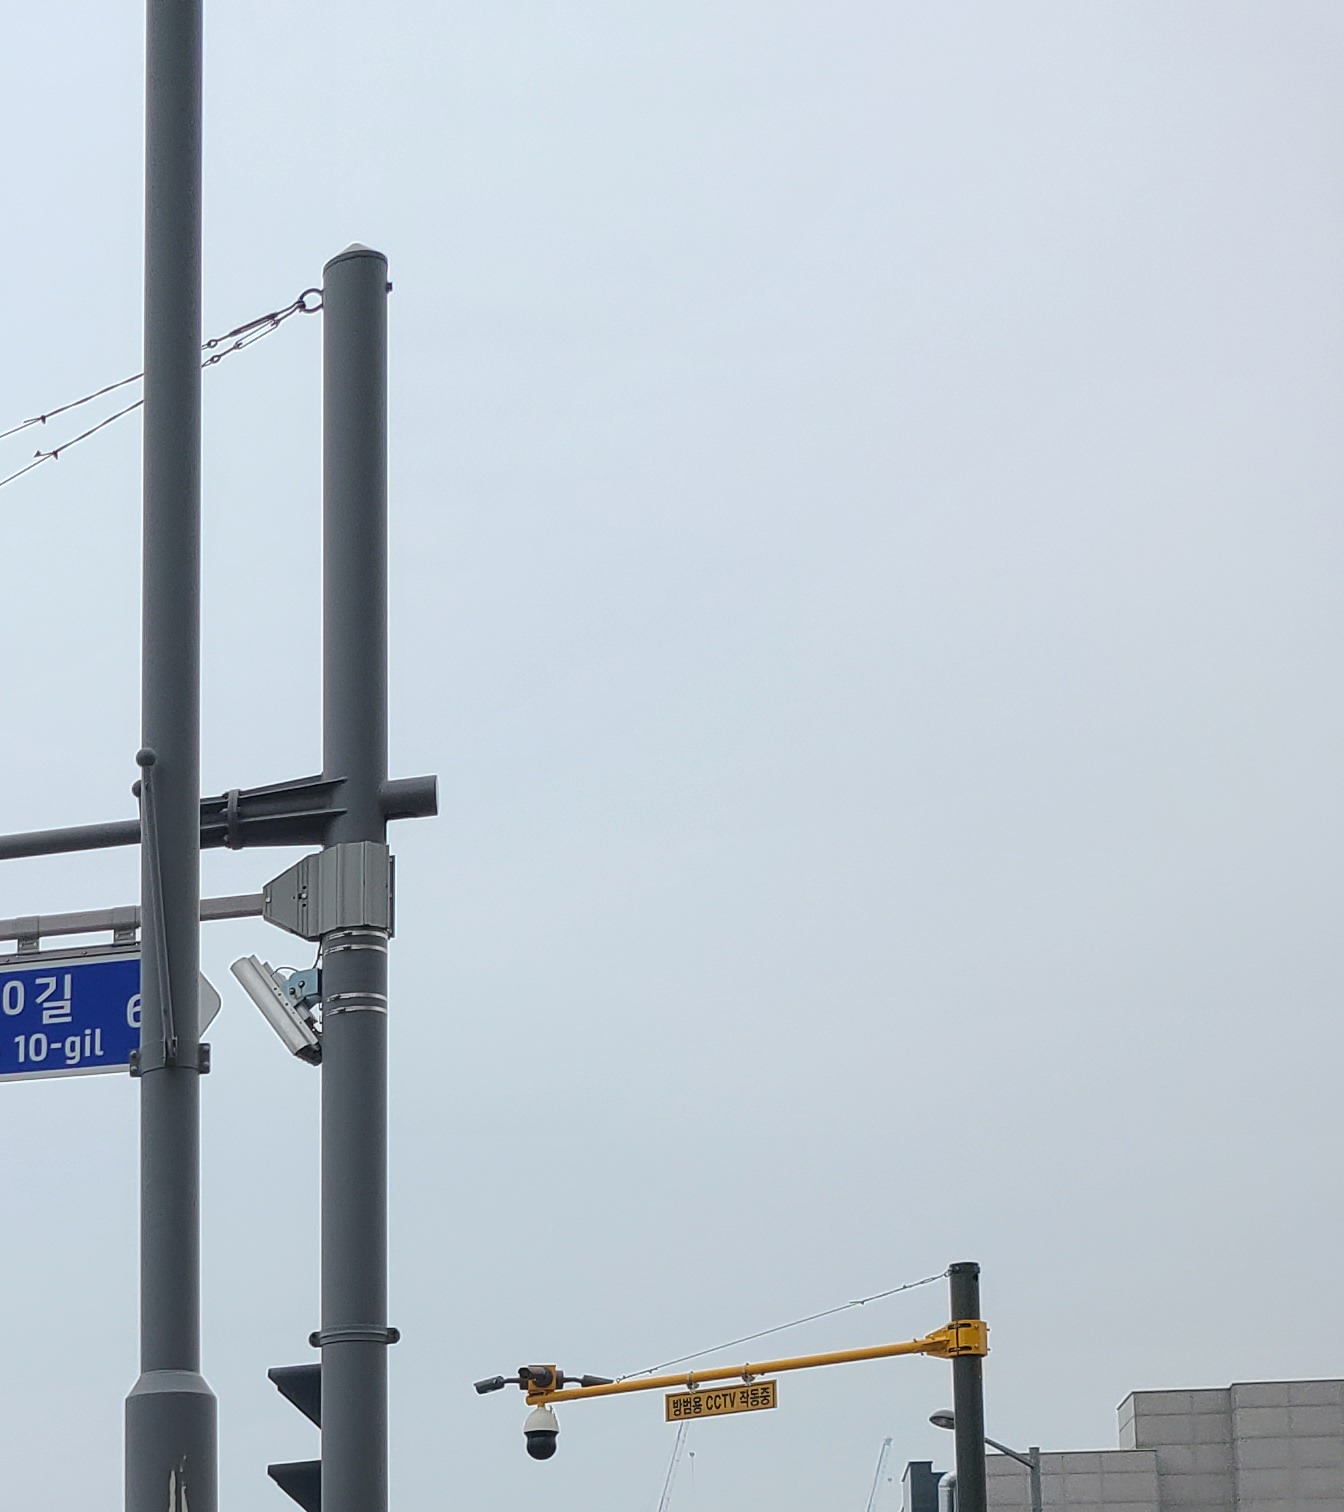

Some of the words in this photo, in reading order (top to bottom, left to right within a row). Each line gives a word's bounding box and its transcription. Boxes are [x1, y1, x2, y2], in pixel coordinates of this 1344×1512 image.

[13, 1027, 105, 1068] 10-gil
[673, 1396, 703, 1417] 방범용
[705, 1391, 737, 1411] CCTV
[739, 1386, 771, 1408] 작동중
